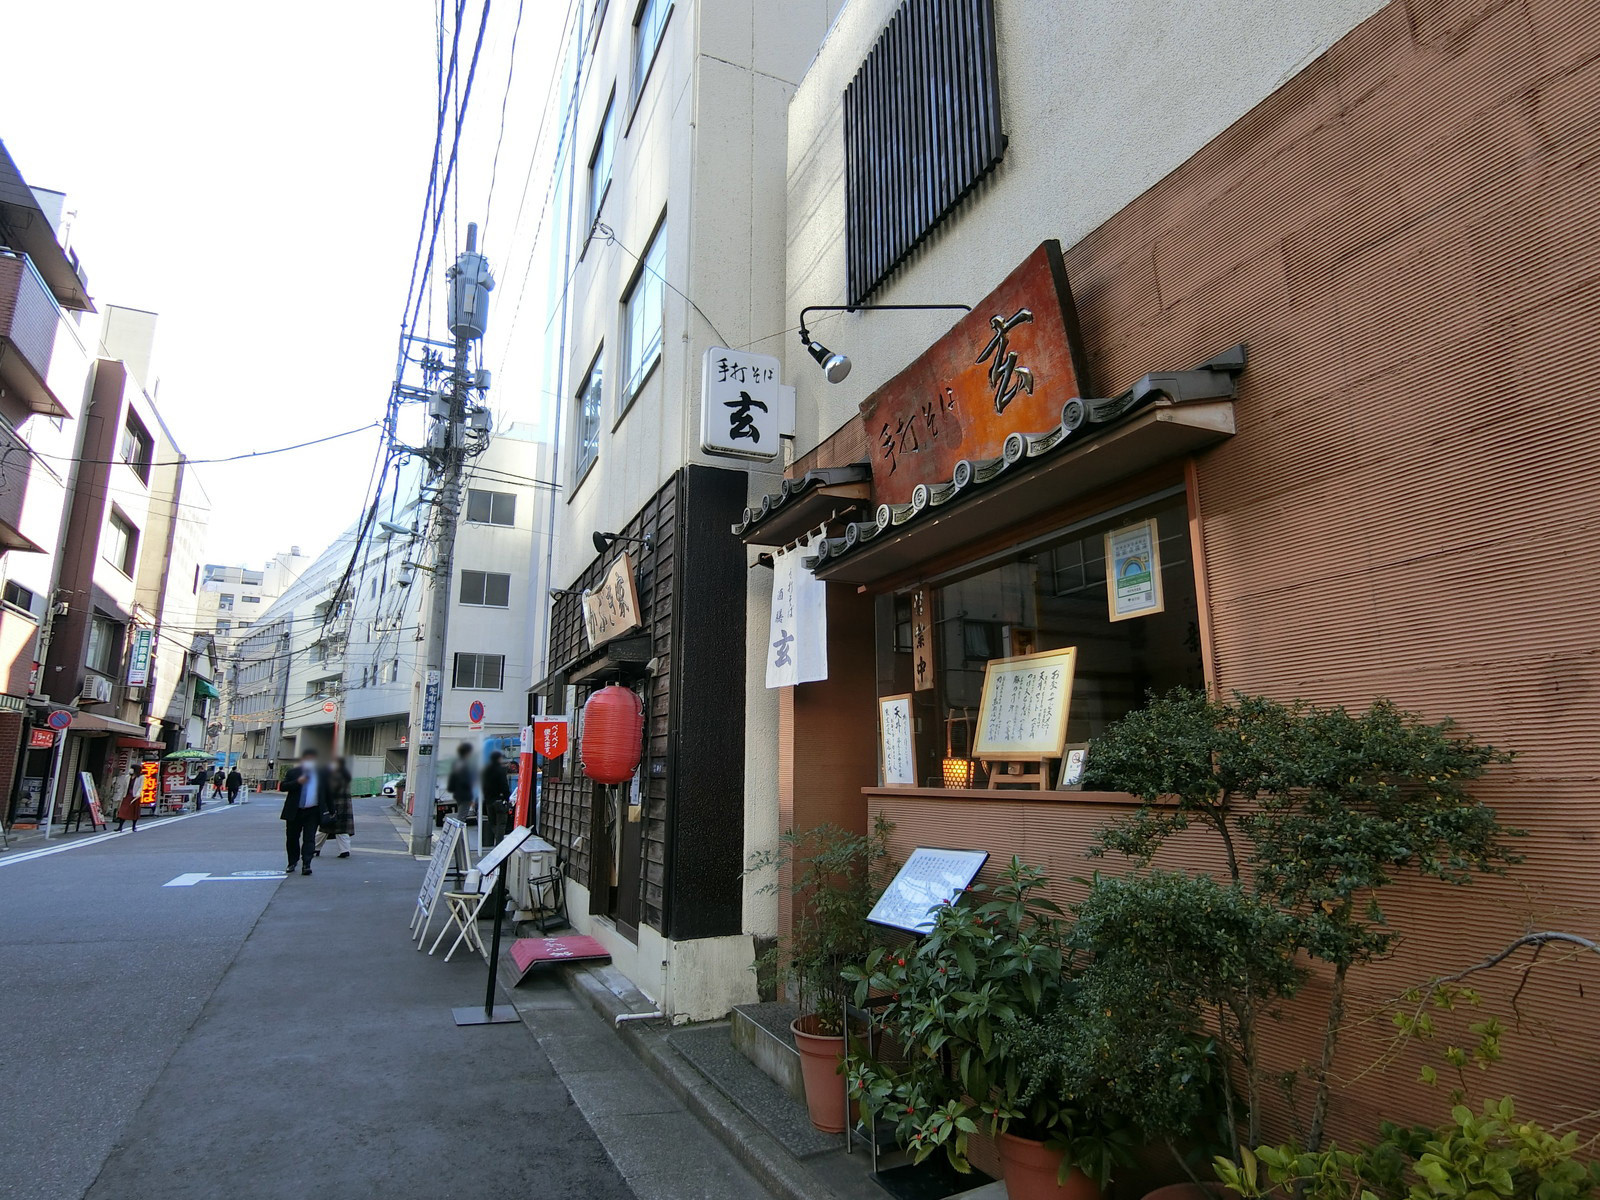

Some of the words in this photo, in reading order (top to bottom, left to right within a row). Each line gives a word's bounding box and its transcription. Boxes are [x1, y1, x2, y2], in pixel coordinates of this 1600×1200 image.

[716, 357, 775, 384] 手打そば
[975, 307, 1033, 415] 玄
[723, 391, 768, 444] 玄
[879, 380, 956, 476] 手打そば
[773, 629, 794, 668] 玄
[141, 761, 158, 803] 予約は
